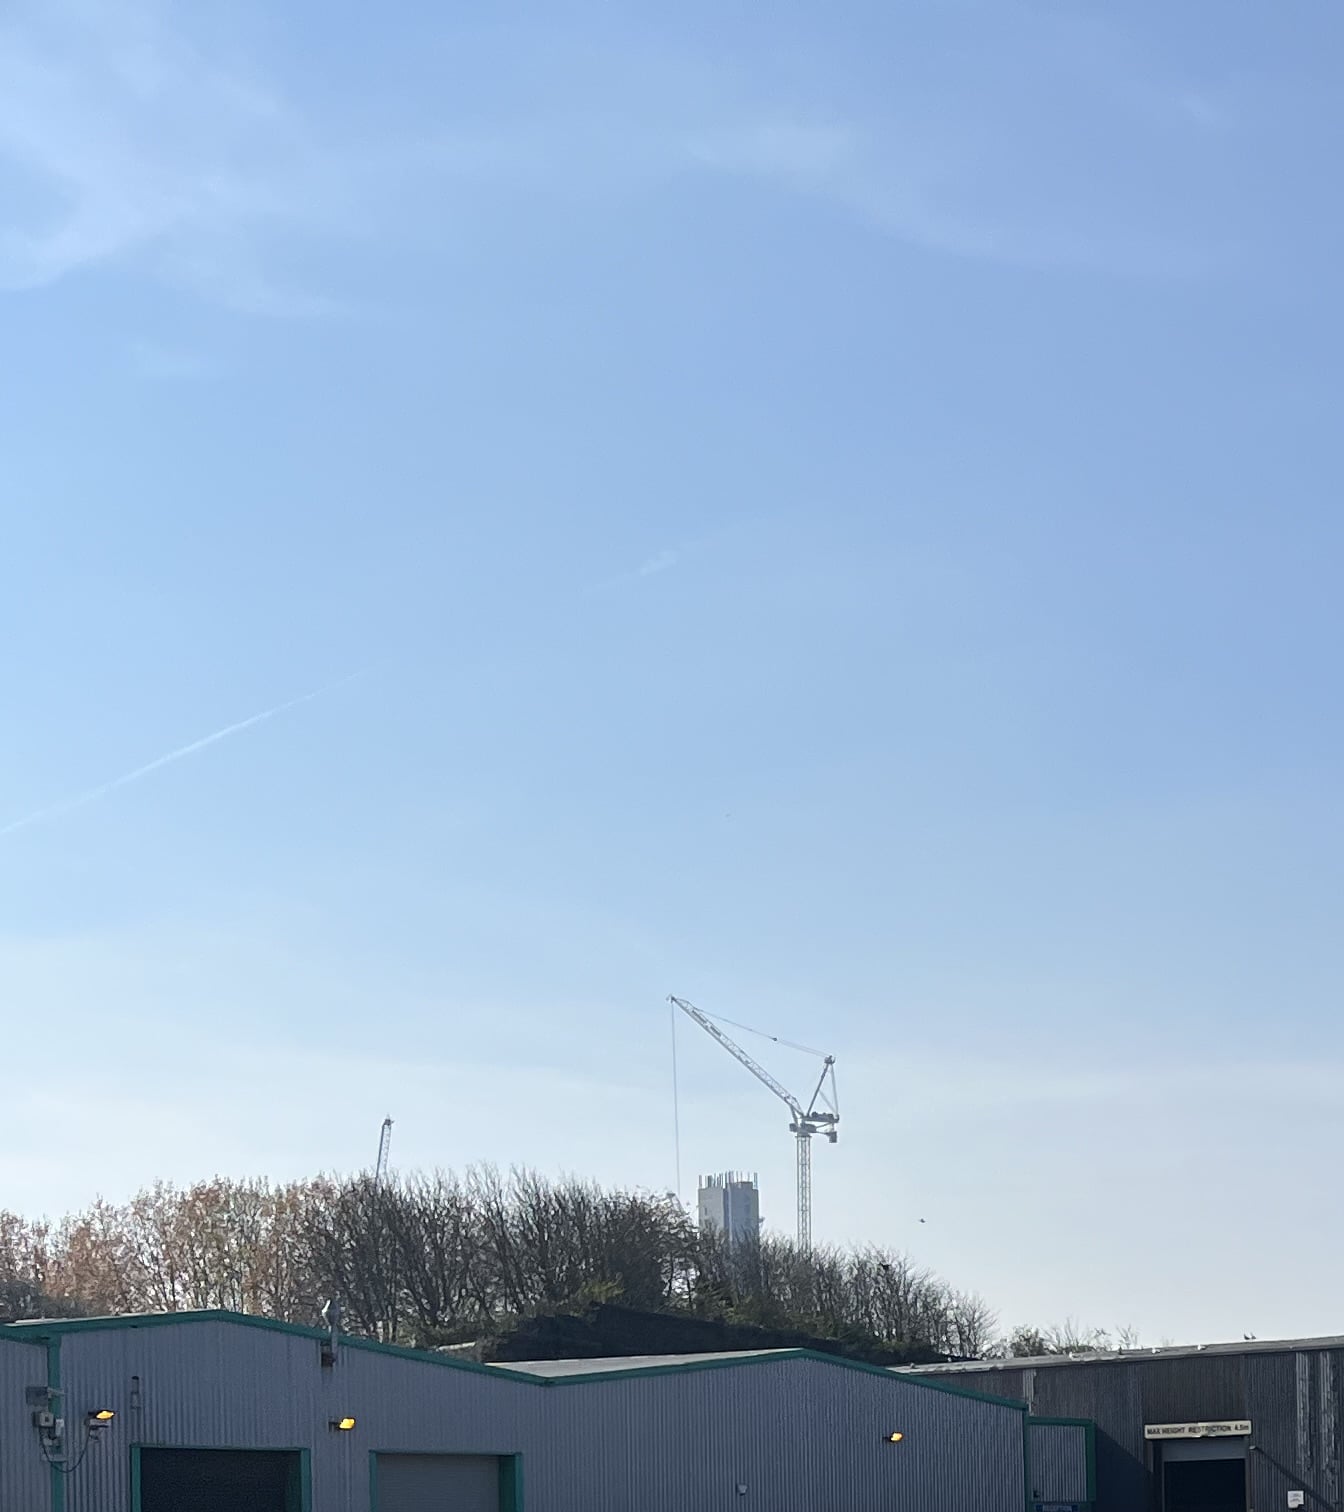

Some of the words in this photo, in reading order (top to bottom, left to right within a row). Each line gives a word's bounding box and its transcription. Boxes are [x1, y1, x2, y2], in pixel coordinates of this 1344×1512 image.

[1147, 1427, 1161, 1435] MAX
[1162, 1426, 1185, 1434] HEIGHT
[1188, 1425, 1232, 1434] RESTRICTION
